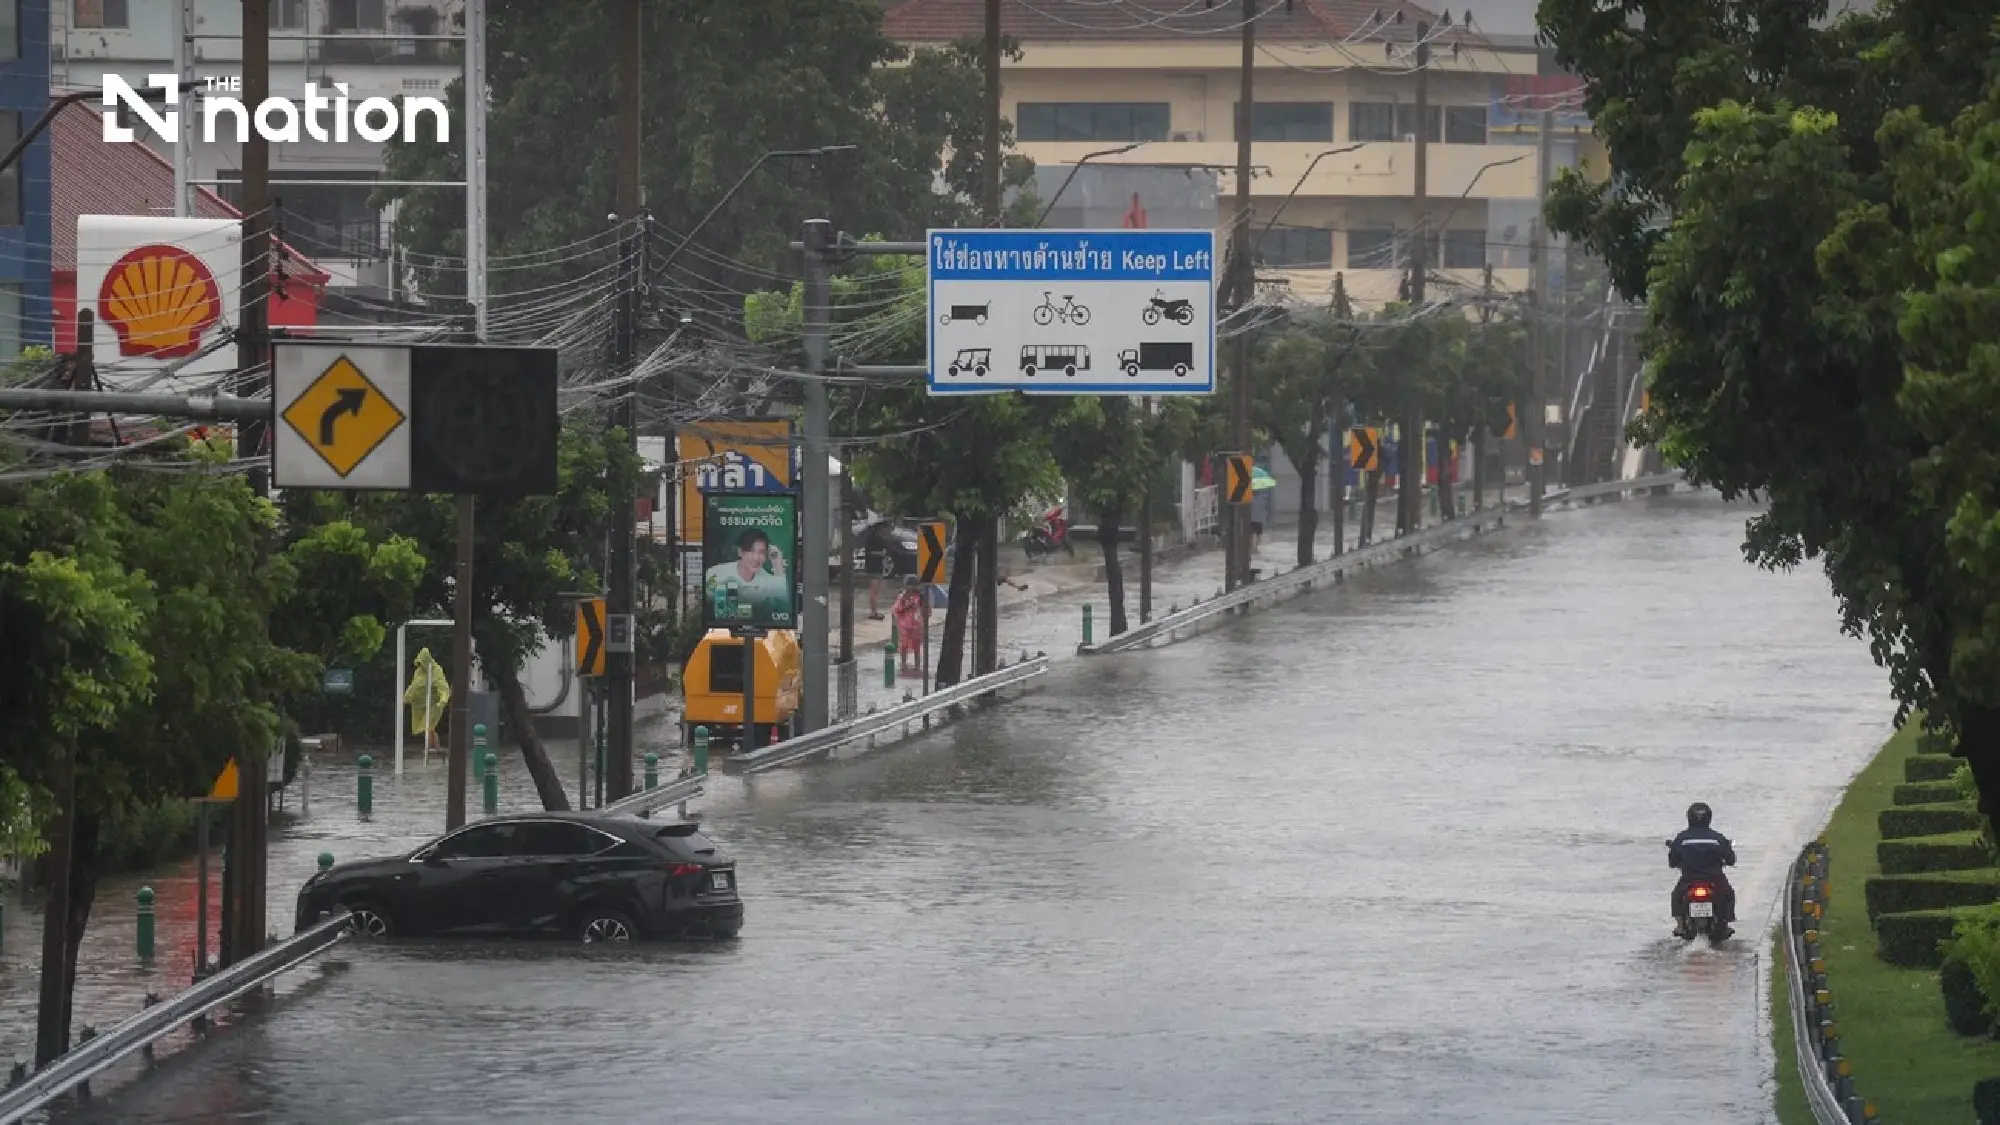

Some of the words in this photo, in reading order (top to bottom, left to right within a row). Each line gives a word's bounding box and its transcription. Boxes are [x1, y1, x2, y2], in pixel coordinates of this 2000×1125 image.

[933, 236, 1112, 270] ใช้ช่องทางด้านซ้าย
[1122, 250, 1166, 274] Keep
[1174, 250, 1210, 270] Left
